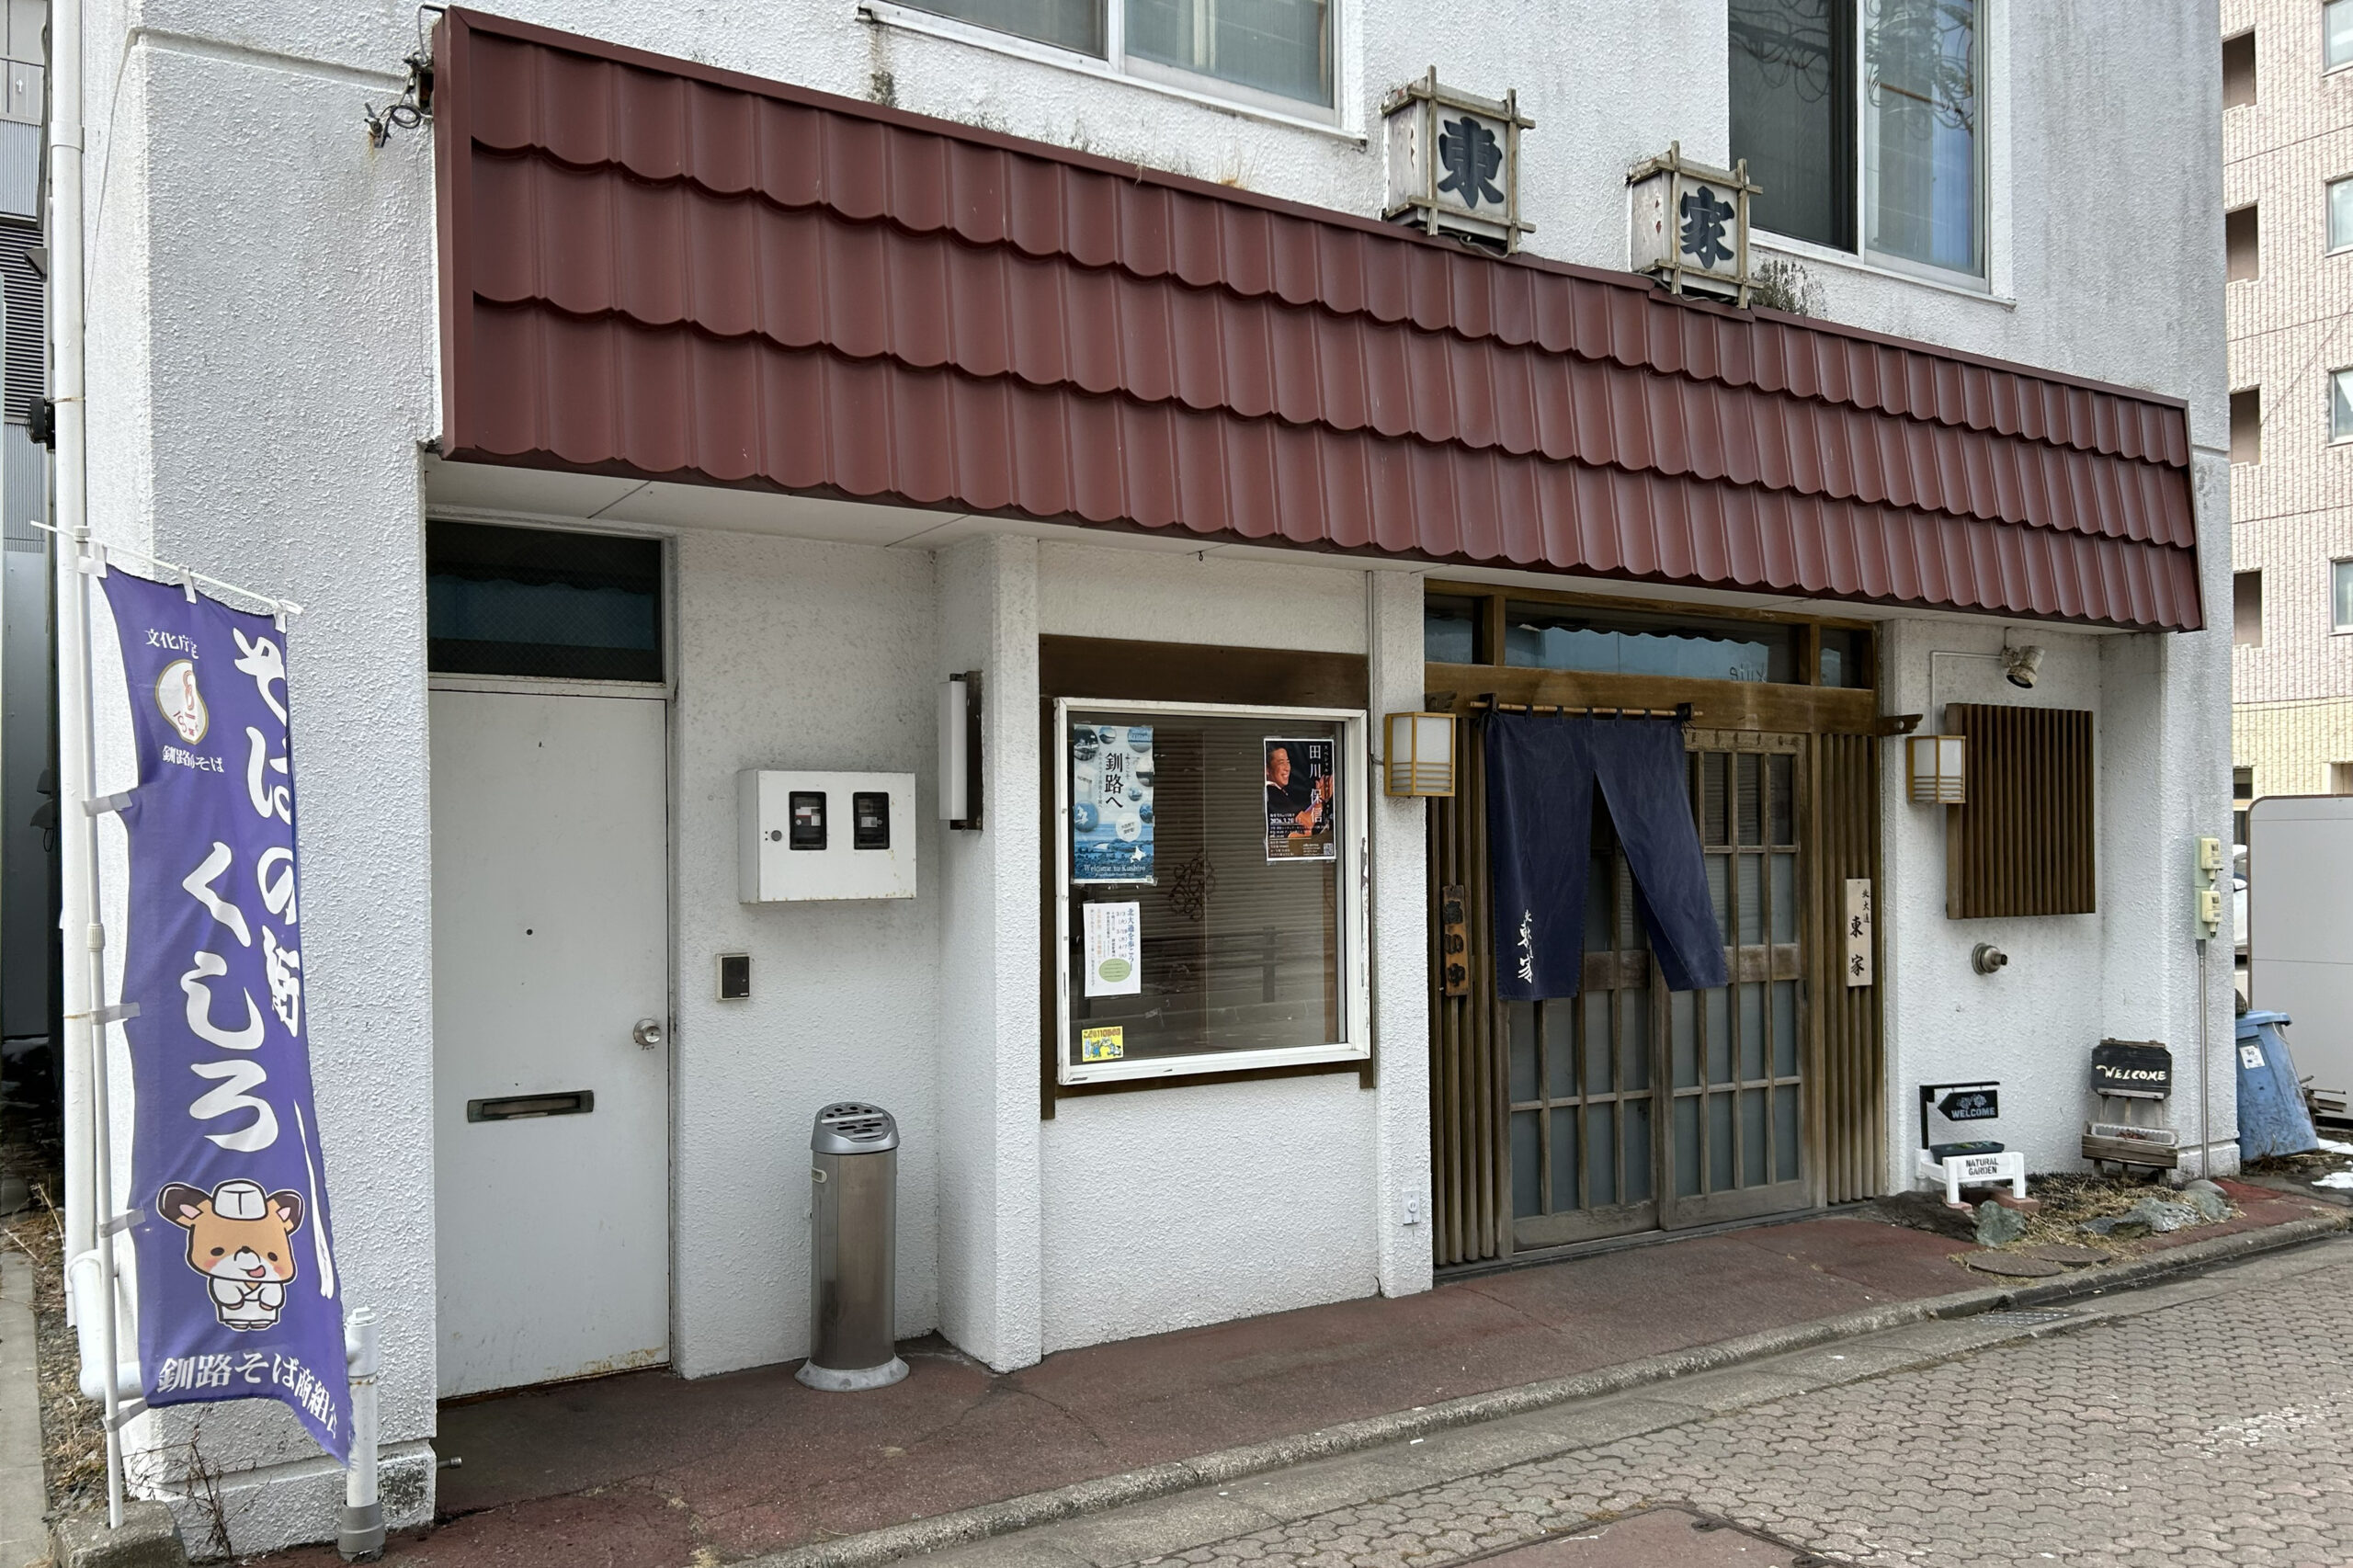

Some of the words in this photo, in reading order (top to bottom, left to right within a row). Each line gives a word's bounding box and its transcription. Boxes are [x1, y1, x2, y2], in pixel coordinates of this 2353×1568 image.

[1438, 116, 1505, 209] 東
[1680, 186, 1734, 269] 家
[1105, 753, 1123, 808] 釧路へ
[1850, 915, 1864, 977] 東家
[180, 840, 279, 1153] くしろ
[2096, 1064, 2166, 1082] WELCOME
[1951, 1107, 1995, 1119] WELCOME
[1966, 1157, 1999, 1167] NATURAL
[1968, 1165, 1997, 1176] GARDEN
